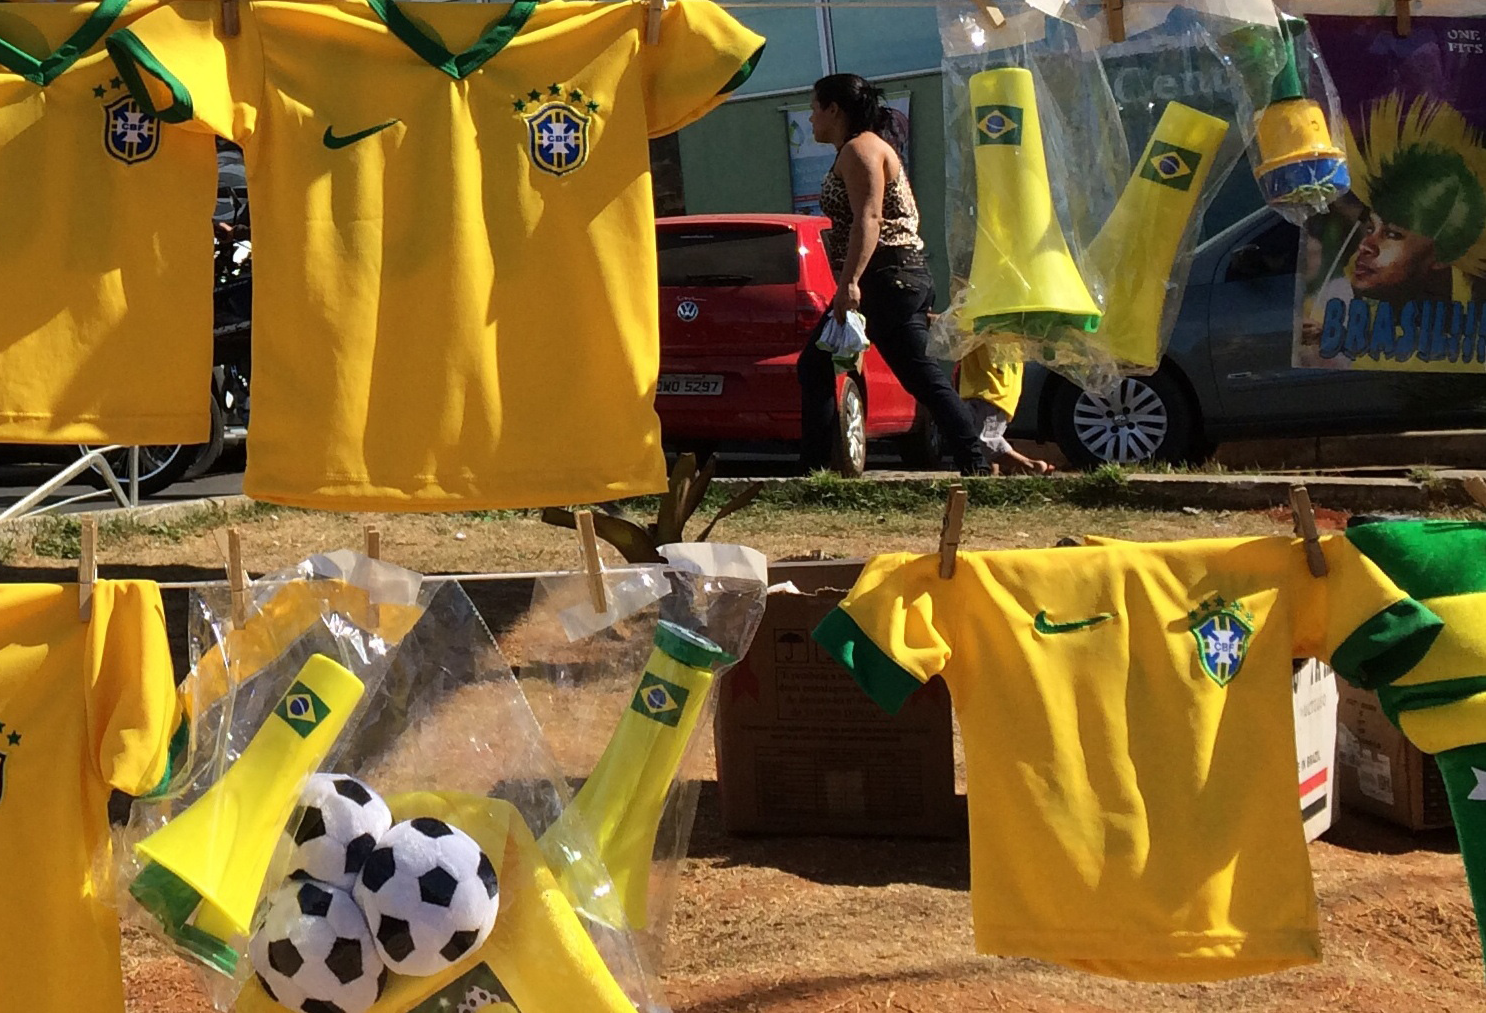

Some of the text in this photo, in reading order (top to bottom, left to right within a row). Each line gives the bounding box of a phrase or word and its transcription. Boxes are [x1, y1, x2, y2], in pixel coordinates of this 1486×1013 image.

[1448, 42, 1484, 54] FITS
[121, 122, 145, 132] CBF
[547, 134, 570, 143] CBF
[684, 380, 719, 393] 5297
[1214, 642, 1236, 653] CBF
